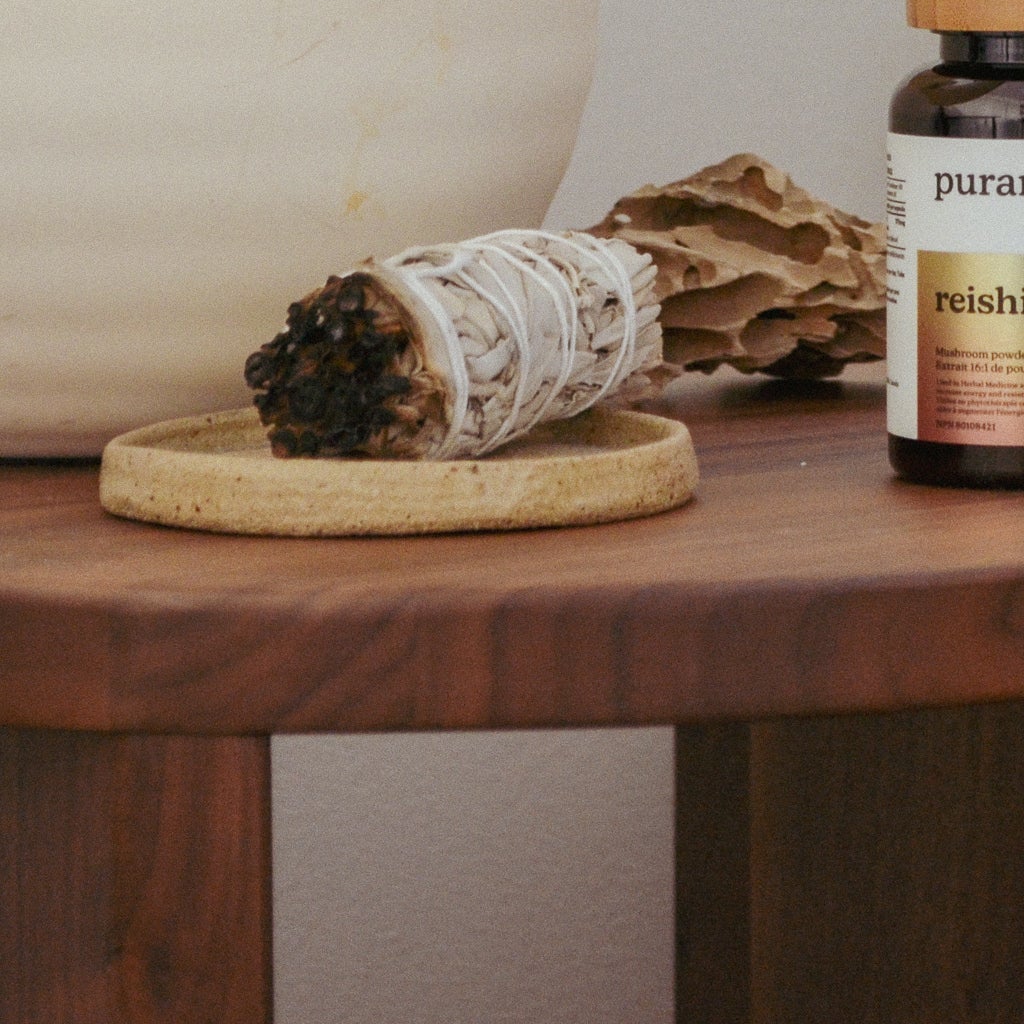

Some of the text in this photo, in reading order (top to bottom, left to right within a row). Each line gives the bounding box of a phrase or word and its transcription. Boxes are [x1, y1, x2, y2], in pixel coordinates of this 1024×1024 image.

[935, 346, 989, 358] Mushroom
[935, 360, 967, 372] Extrait
[970, 363, 988, 373] 16:1
[990, 364, 1004, 373] de
